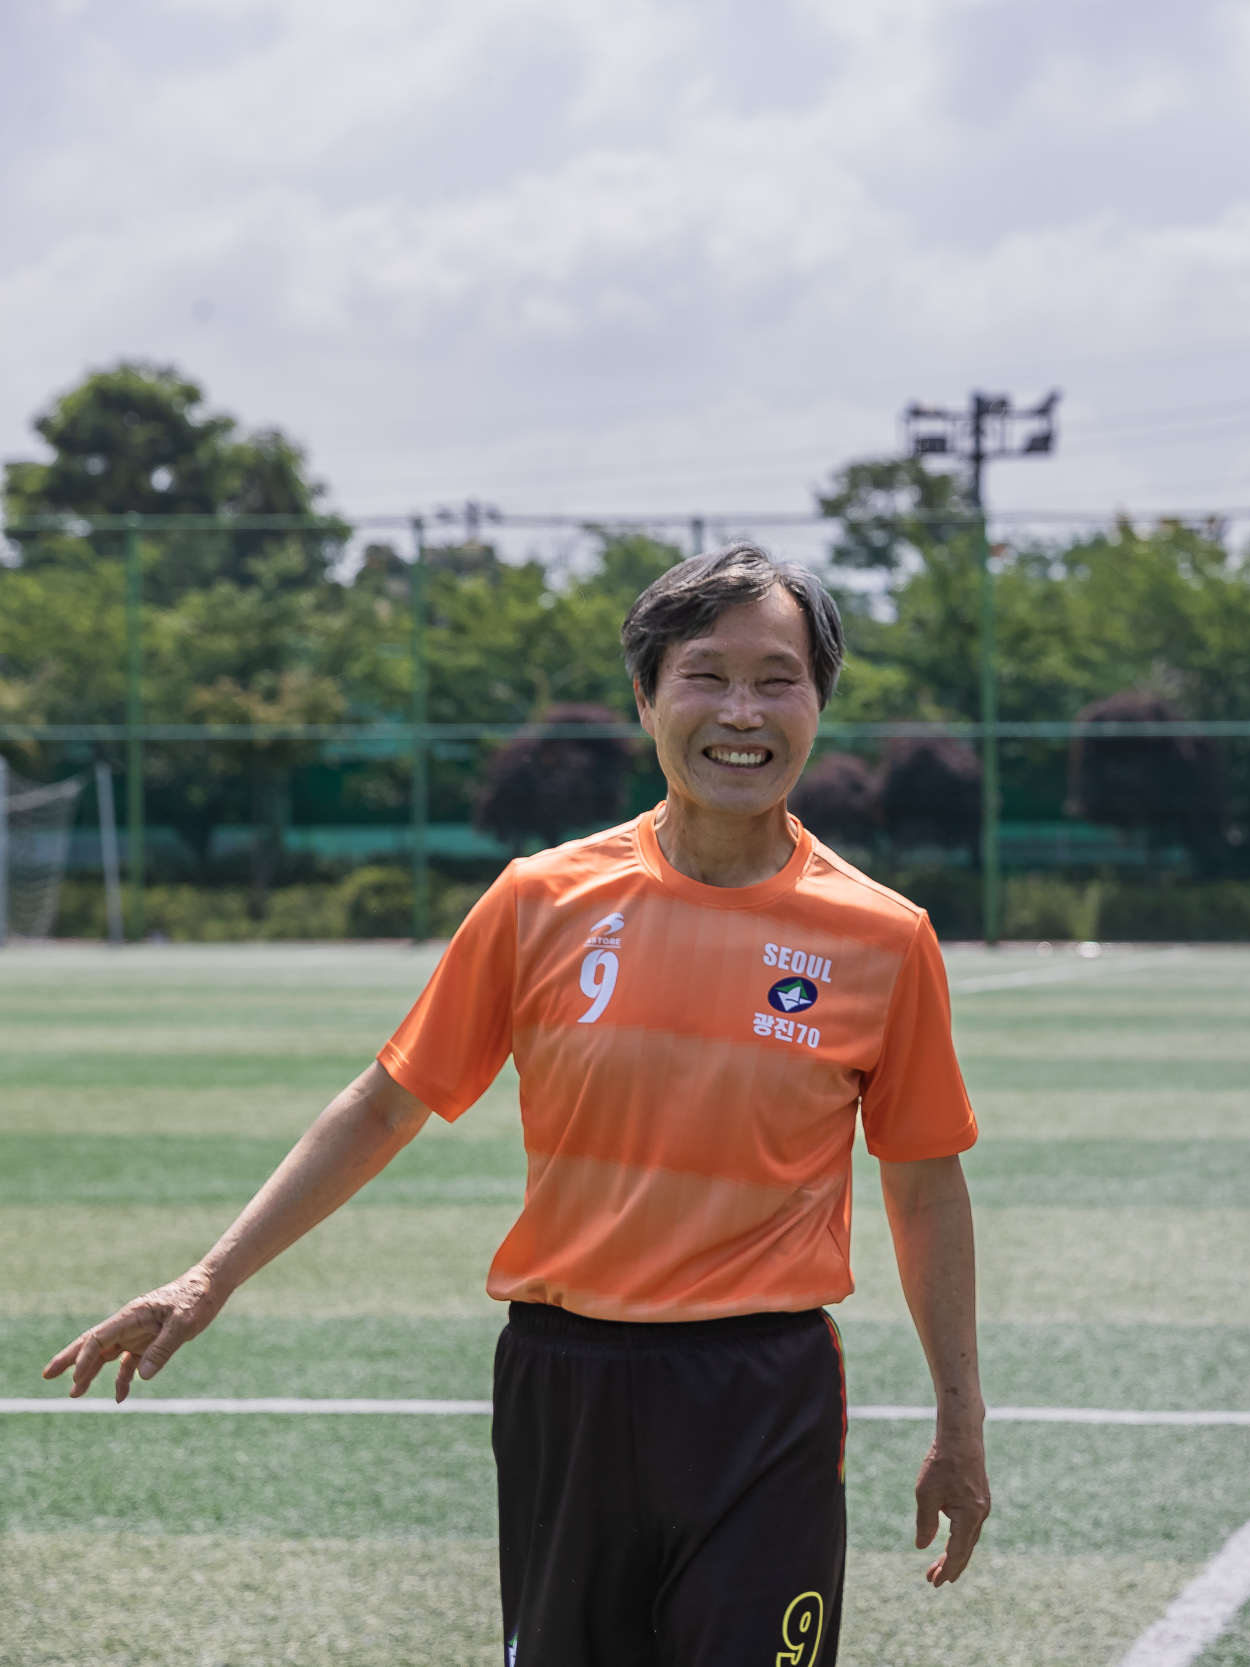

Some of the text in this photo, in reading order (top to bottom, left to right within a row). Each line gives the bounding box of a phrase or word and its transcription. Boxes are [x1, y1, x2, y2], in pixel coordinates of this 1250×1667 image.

[577, 949, 619, 1023] 9
[763, 942, 832, 983] SEOUL
[753, 1012, 820, 1049] 광진70
[776, 1591, 823, 1667] 9
